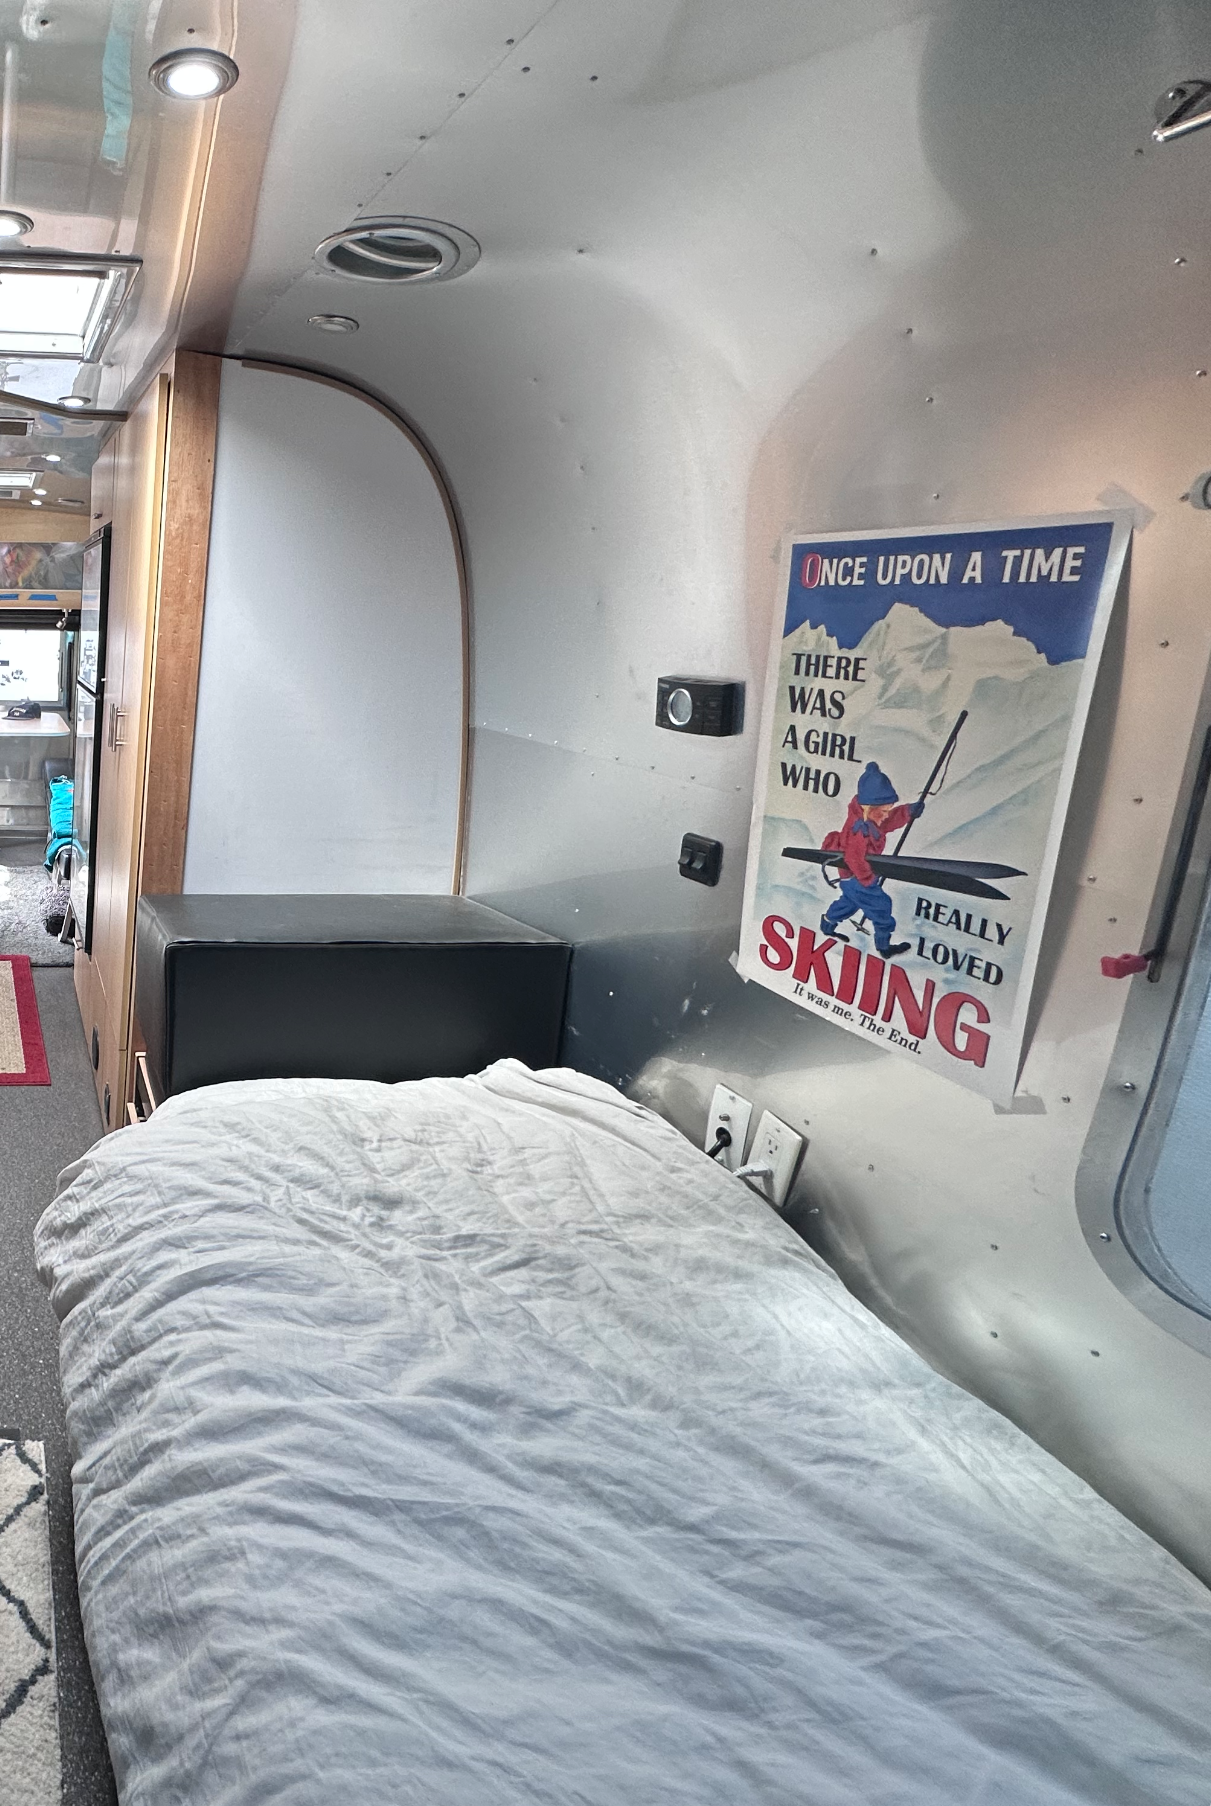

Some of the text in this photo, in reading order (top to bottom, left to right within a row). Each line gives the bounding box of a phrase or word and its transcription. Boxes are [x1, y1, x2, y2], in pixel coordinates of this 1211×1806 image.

[802, 545, 1086, 588] ONCE UPON A TIME
[791, 652, 868, 683] THERE
[788, 685, 846, 720] WAS
[781, 724, 862, 763] A GIRL
[780, 761, 841, 798] WHO
[914, 896, 1012, 947] REALLY
[916, 936, 1004, 986] LOVED
[759, 914, 991, 1069] SKIING
[793, 982, 922, 1055] It was me. The End.
